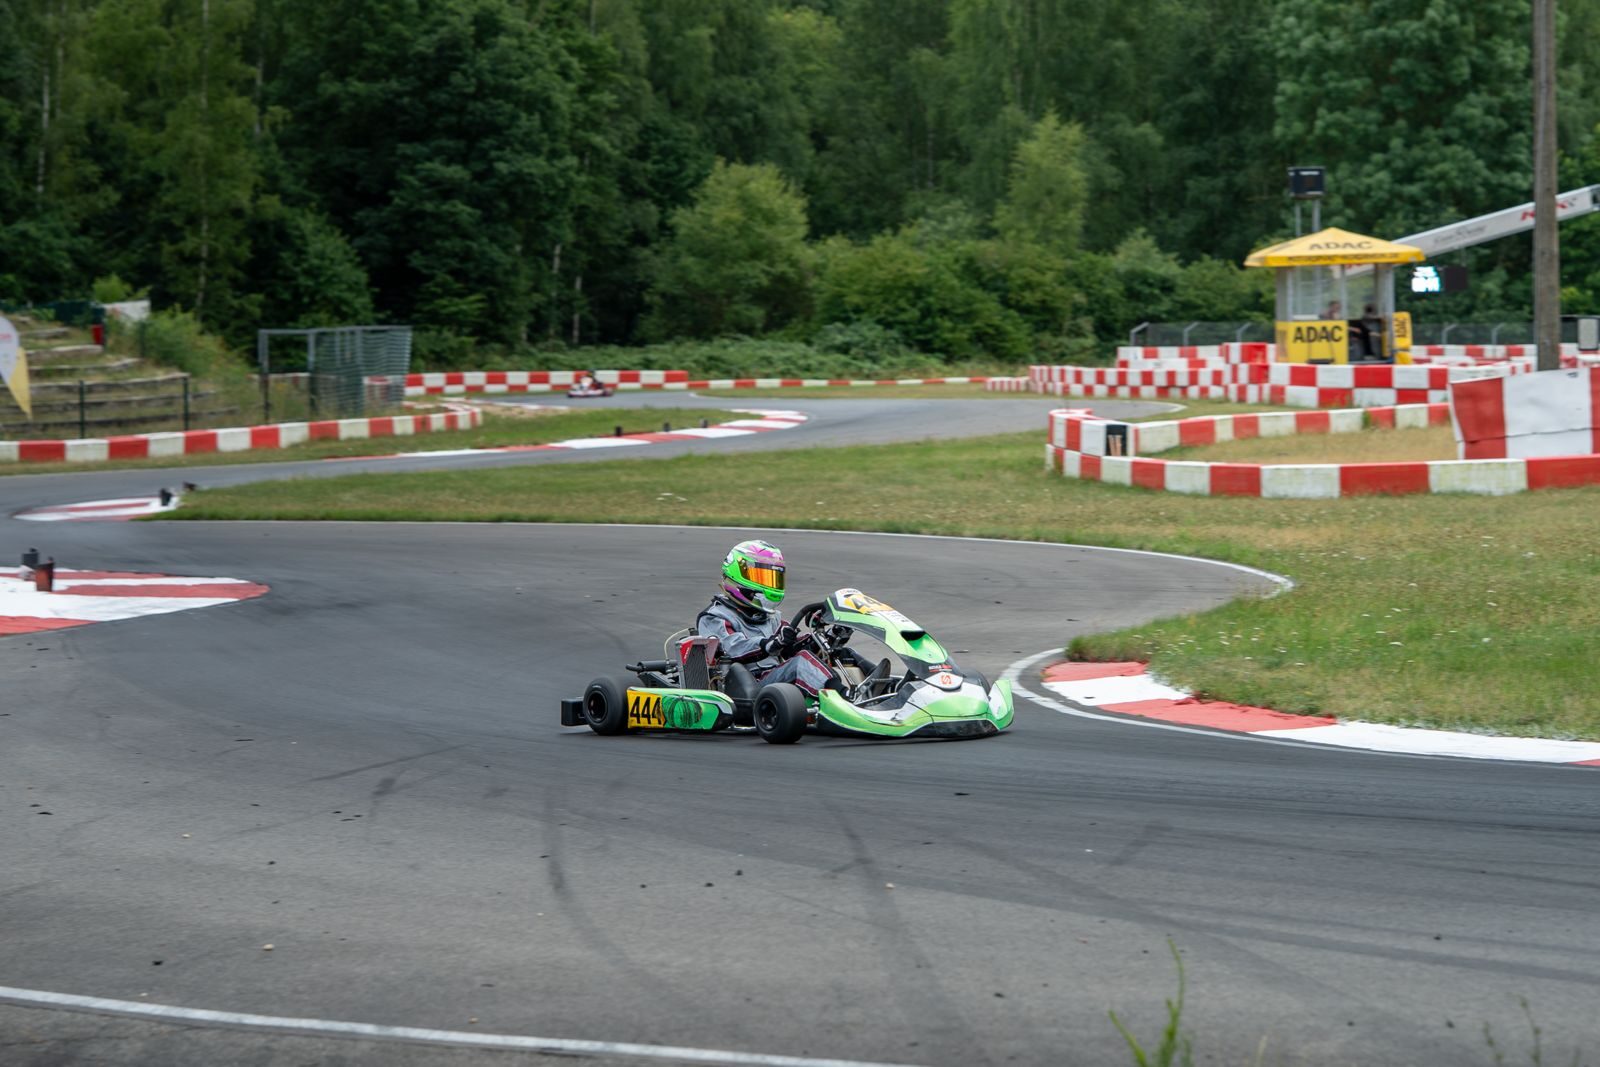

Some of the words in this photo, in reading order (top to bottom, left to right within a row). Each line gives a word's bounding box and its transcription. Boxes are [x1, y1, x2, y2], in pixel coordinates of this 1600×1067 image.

[1309, 241, 1373, 250] ADAC
[1293, 325, 1343, 343] ADAC
[630, 696, 662, 725] 444
